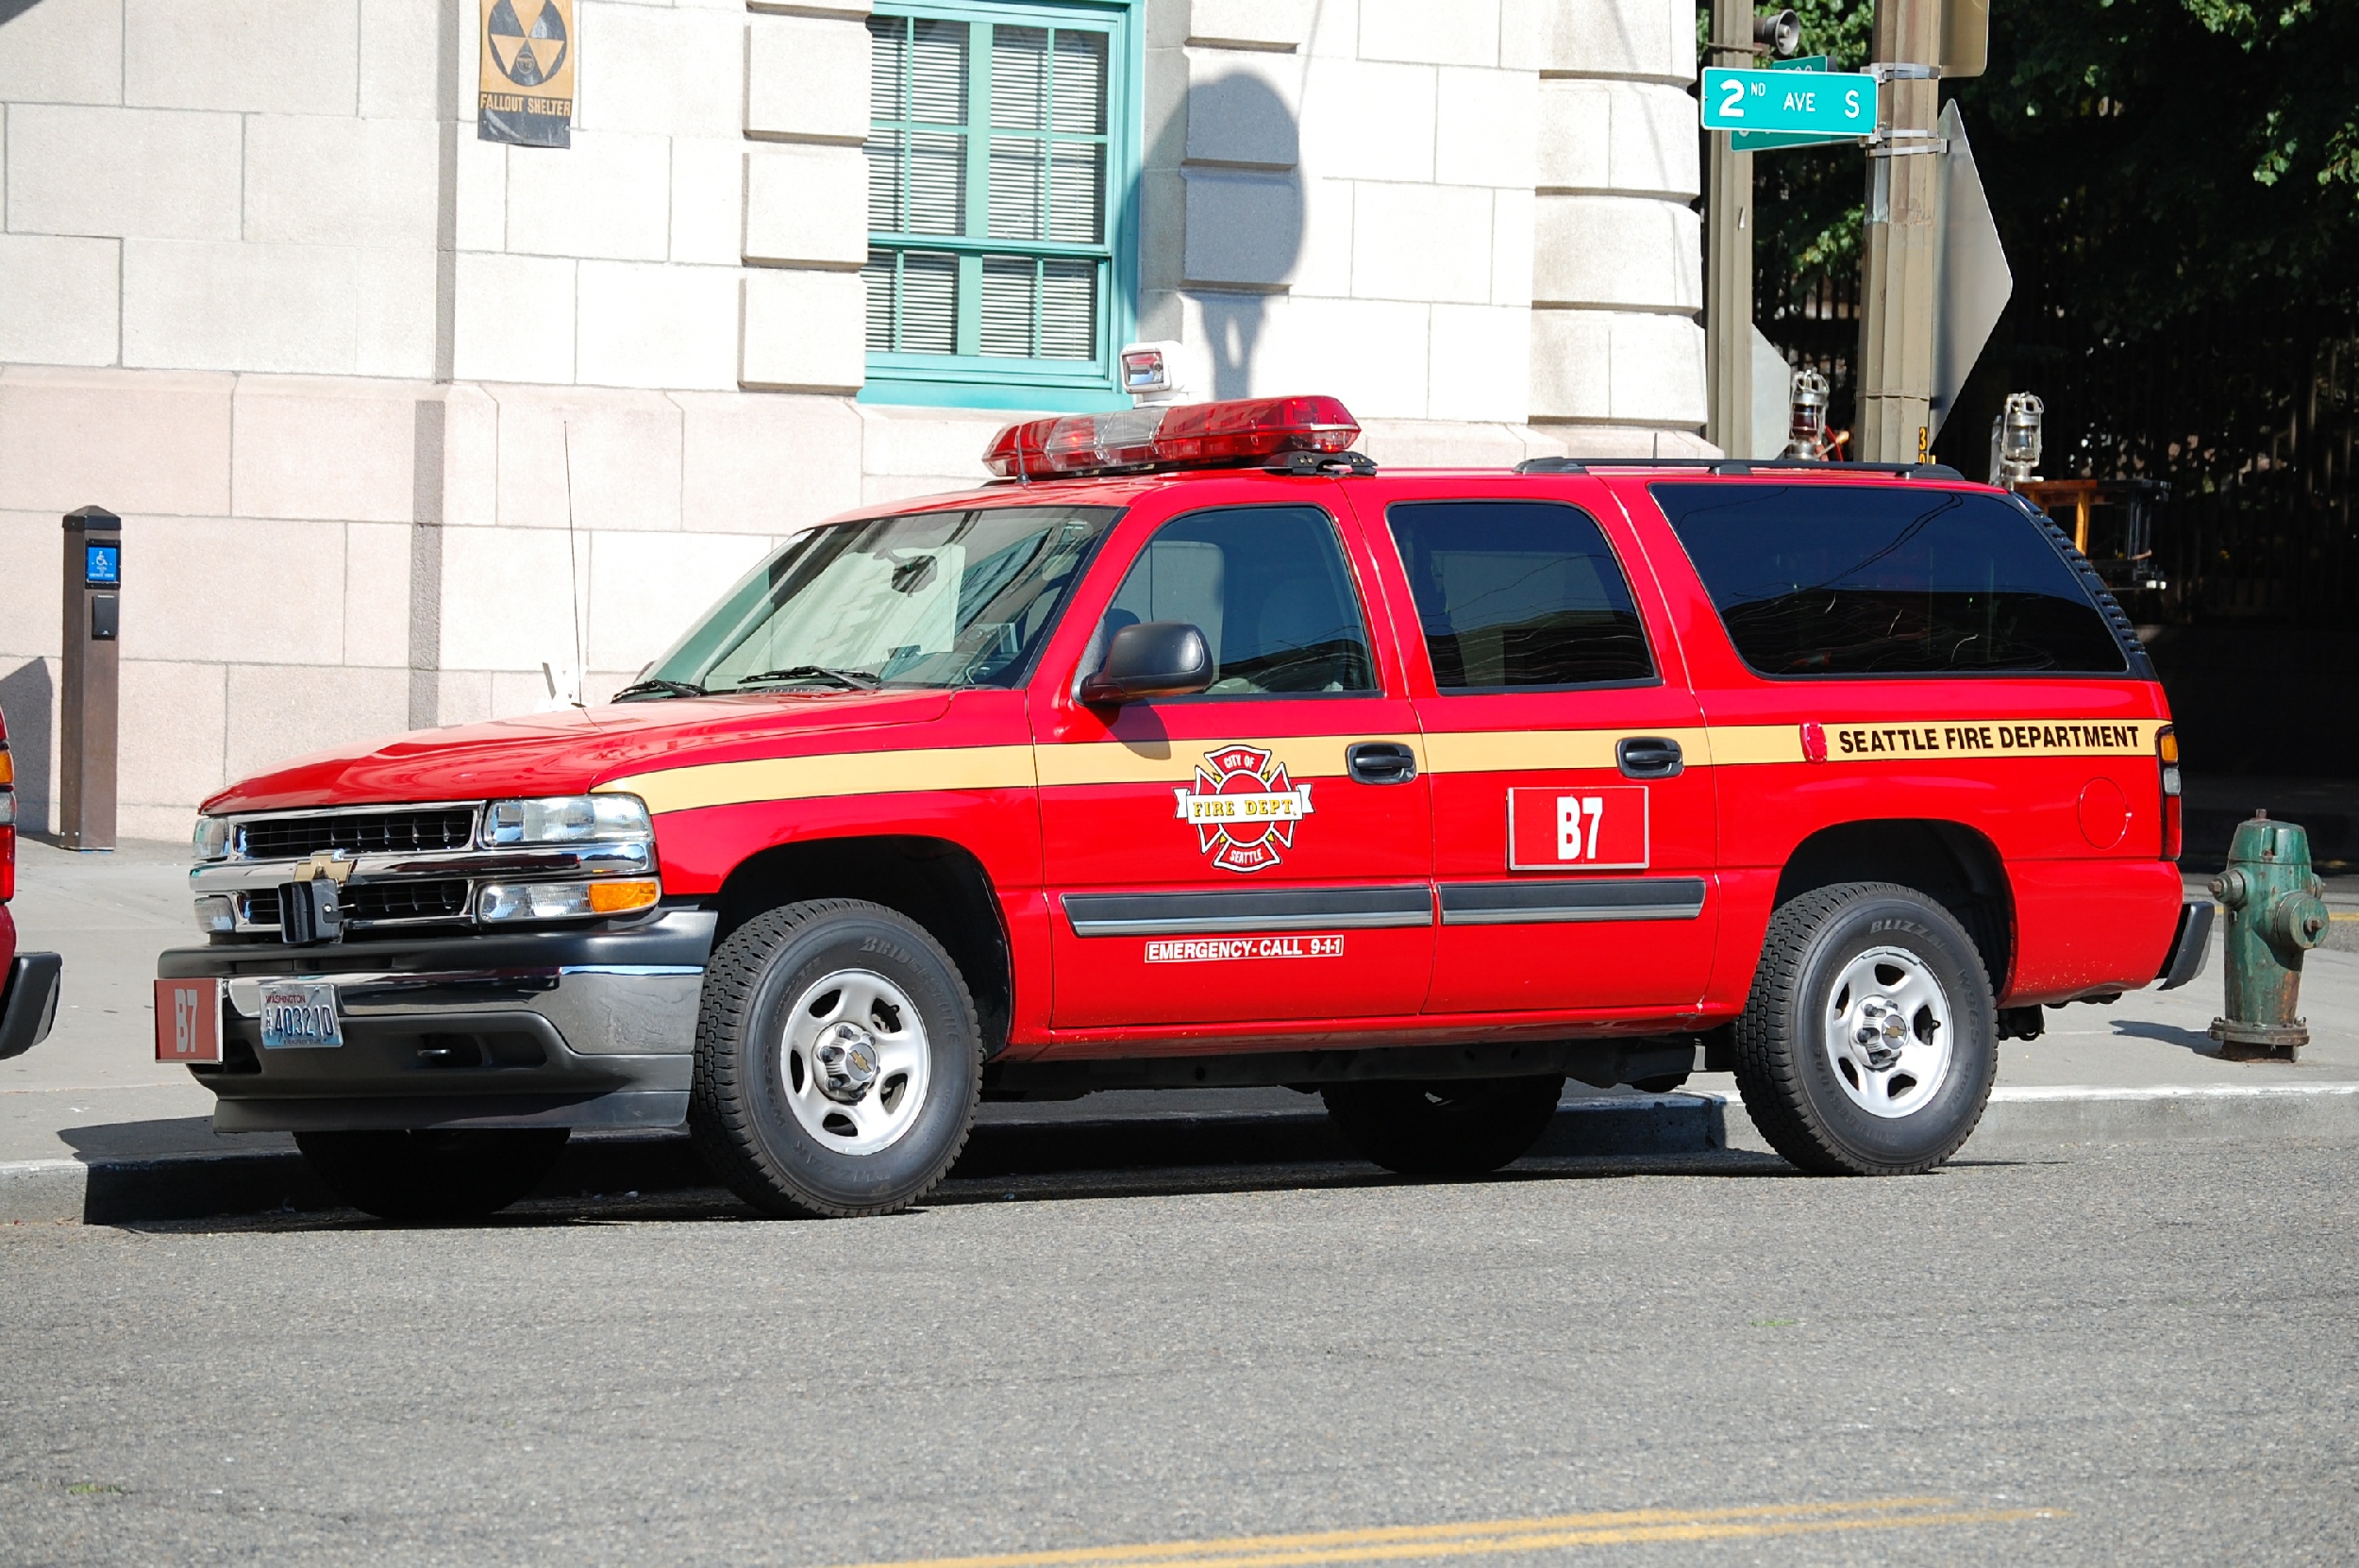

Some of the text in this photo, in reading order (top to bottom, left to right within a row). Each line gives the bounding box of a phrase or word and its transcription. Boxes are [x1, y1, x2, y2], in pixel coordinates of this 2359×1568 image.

[480, 93, 571, 116] FALLOUT SHELTER
[1719, 78, 1860, 118] 2ND AVE S
[1839, 726, 2139, 753] SEATTLE FIRE DEPARTMENT
[1224, 754, 1256, 768] CITY OF
[1193, 799, 1297, 817] FIRE DEPT.
[1557, 795, 1603, 860] B7
[1230, 848, 1263, 864] SEATTLE
[1311, 938, 1340, 954] 9-1-1
[265, 994, 307, 1005] WASHINGTON
[174, 989, 197, 1053] B7
